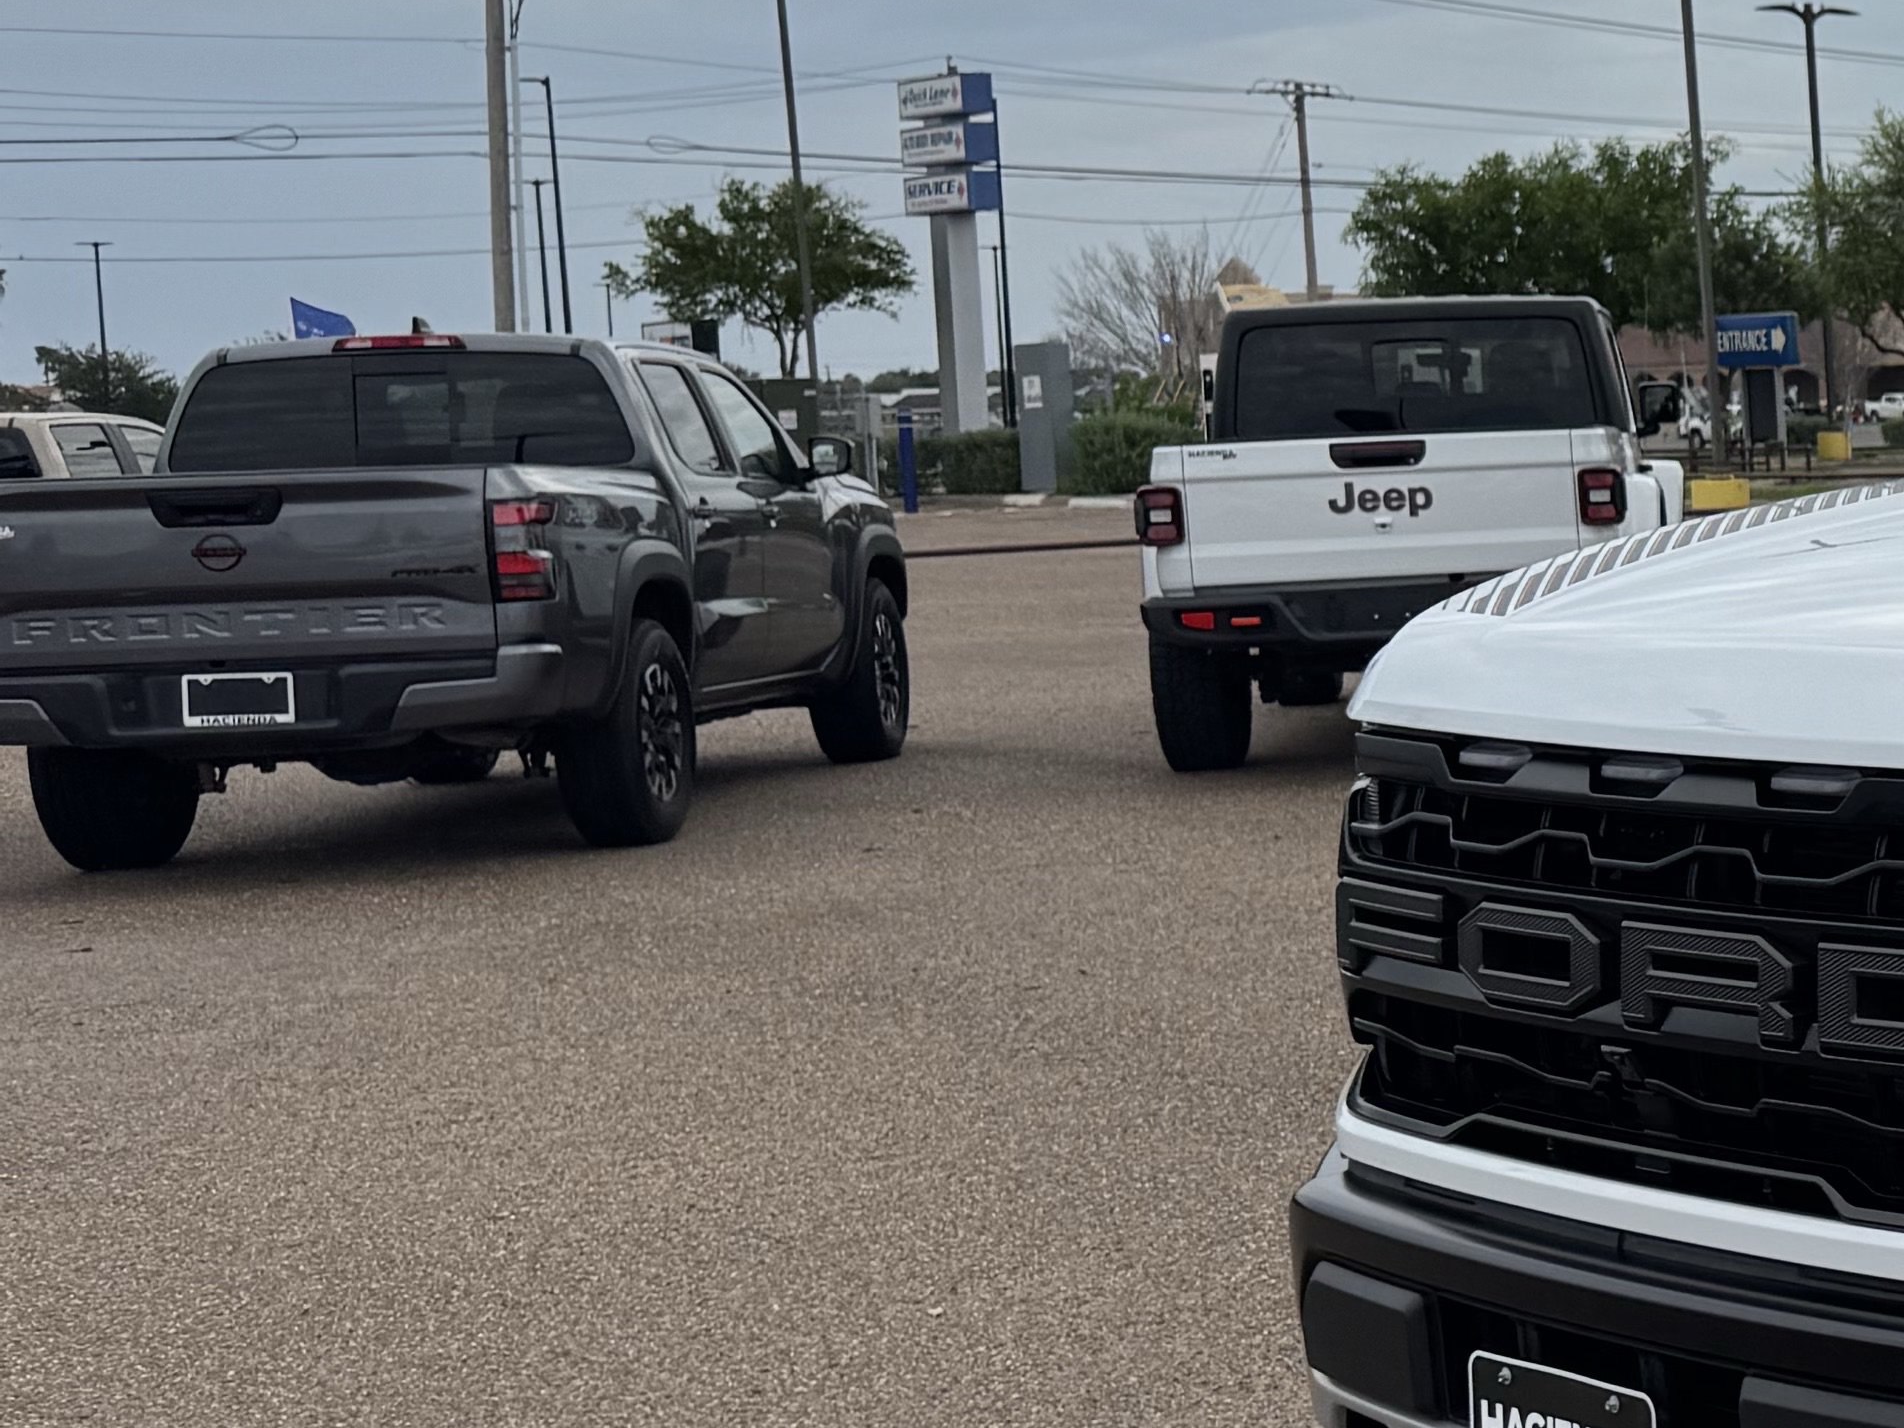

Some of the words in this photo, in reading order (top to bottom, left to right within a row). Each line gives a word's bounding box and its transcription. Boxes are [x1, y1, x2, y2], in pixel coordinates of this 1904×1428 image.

[907, 179, 957, 199] SERVICE
[1717, 329, 1768, 352] ENTRANCE
[1328, 482, 1433, 517] Jeep
[12, 602, 447, 645] FRONTIER
[201, 714, 278, 727] HACIENDA
